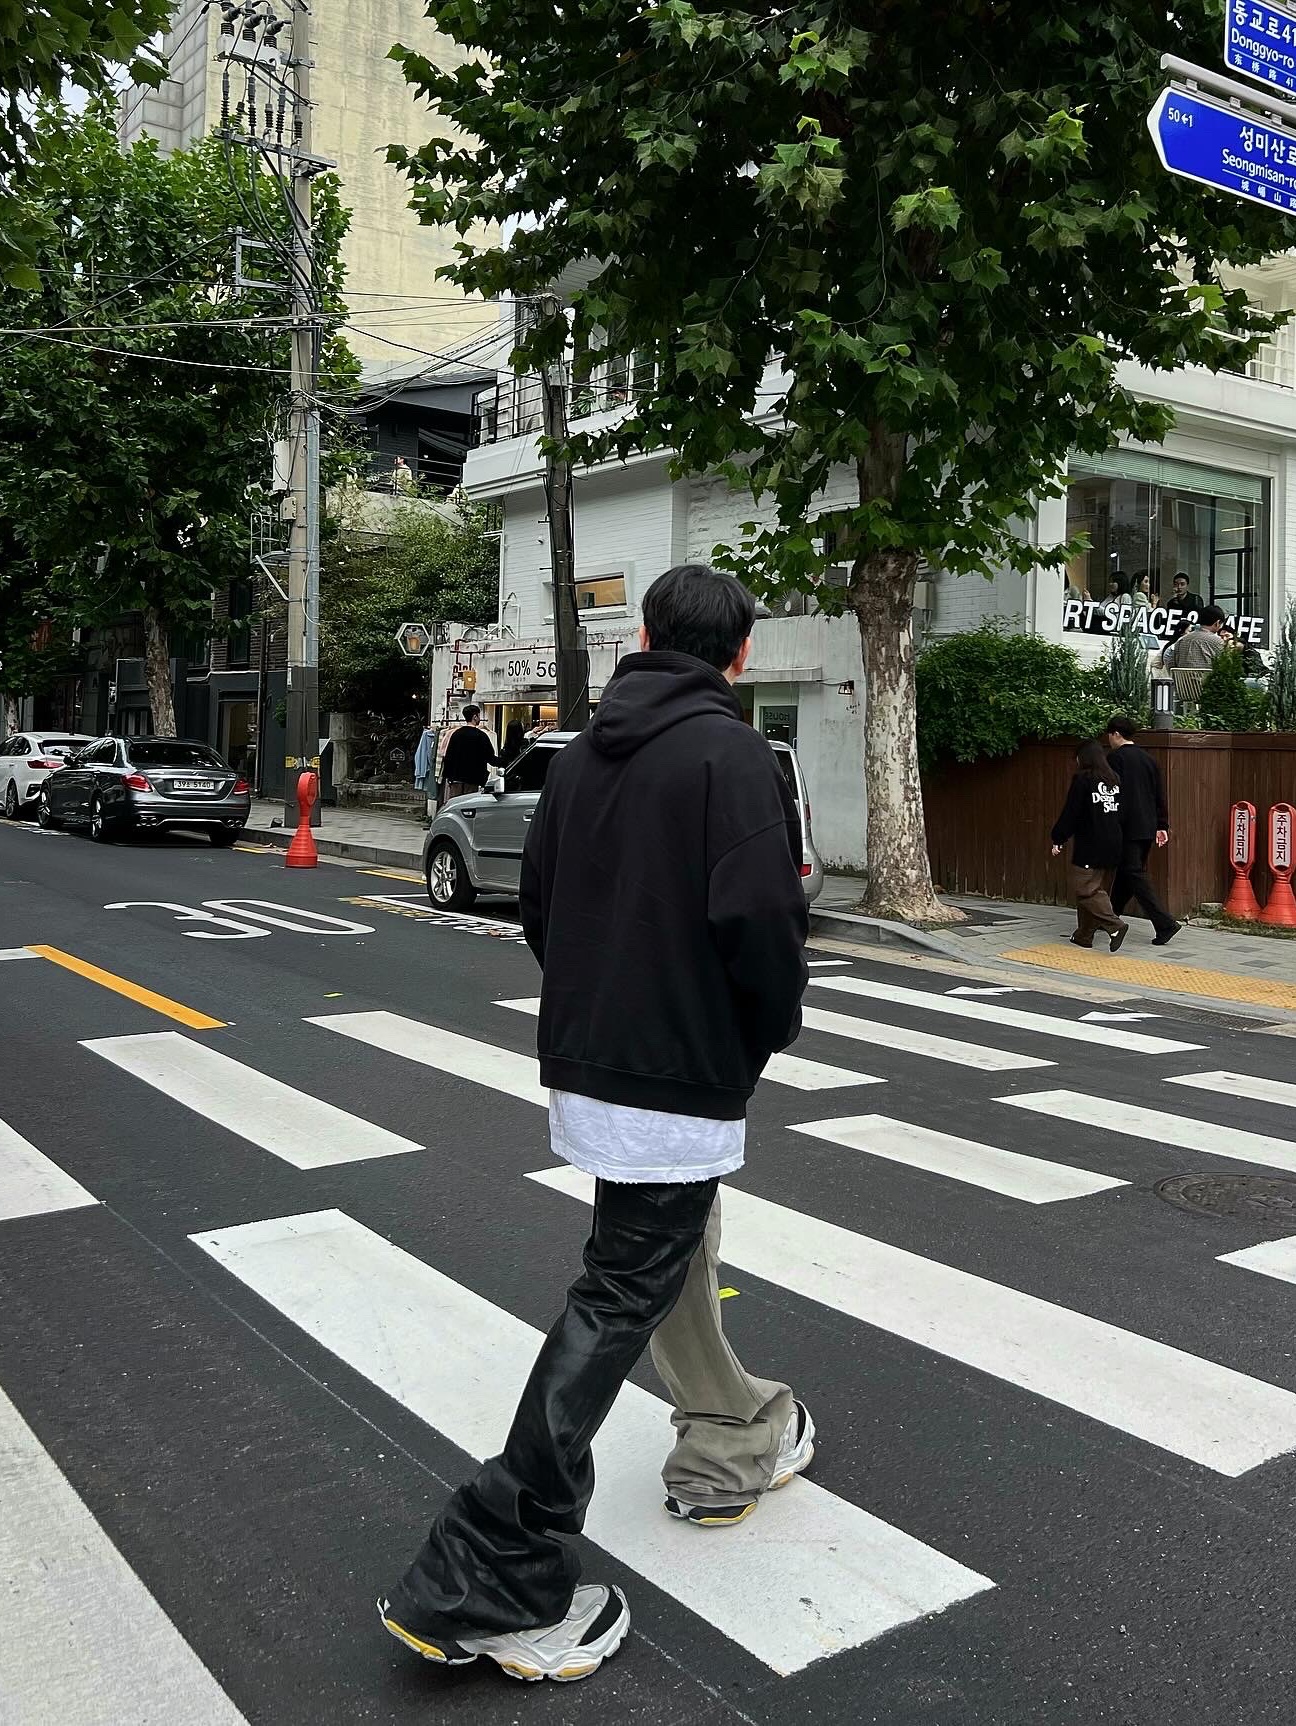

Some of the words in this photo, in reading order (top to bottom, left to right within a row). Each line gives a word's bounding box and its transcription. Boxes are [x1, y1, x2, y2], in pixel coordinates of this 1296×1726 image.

[1231, 28, 1295, 69] Donggyo-ro
[1101, 602, 1183, 636] SPACE
[1225, 614, 1265, 643] AFE
[507, 659, 531, 677] 50%
[1235, 811, 1246, 859] 주차금지
[1276, 814, 1288, 862] 주차금지
[103, 899, 377, 940] 30
